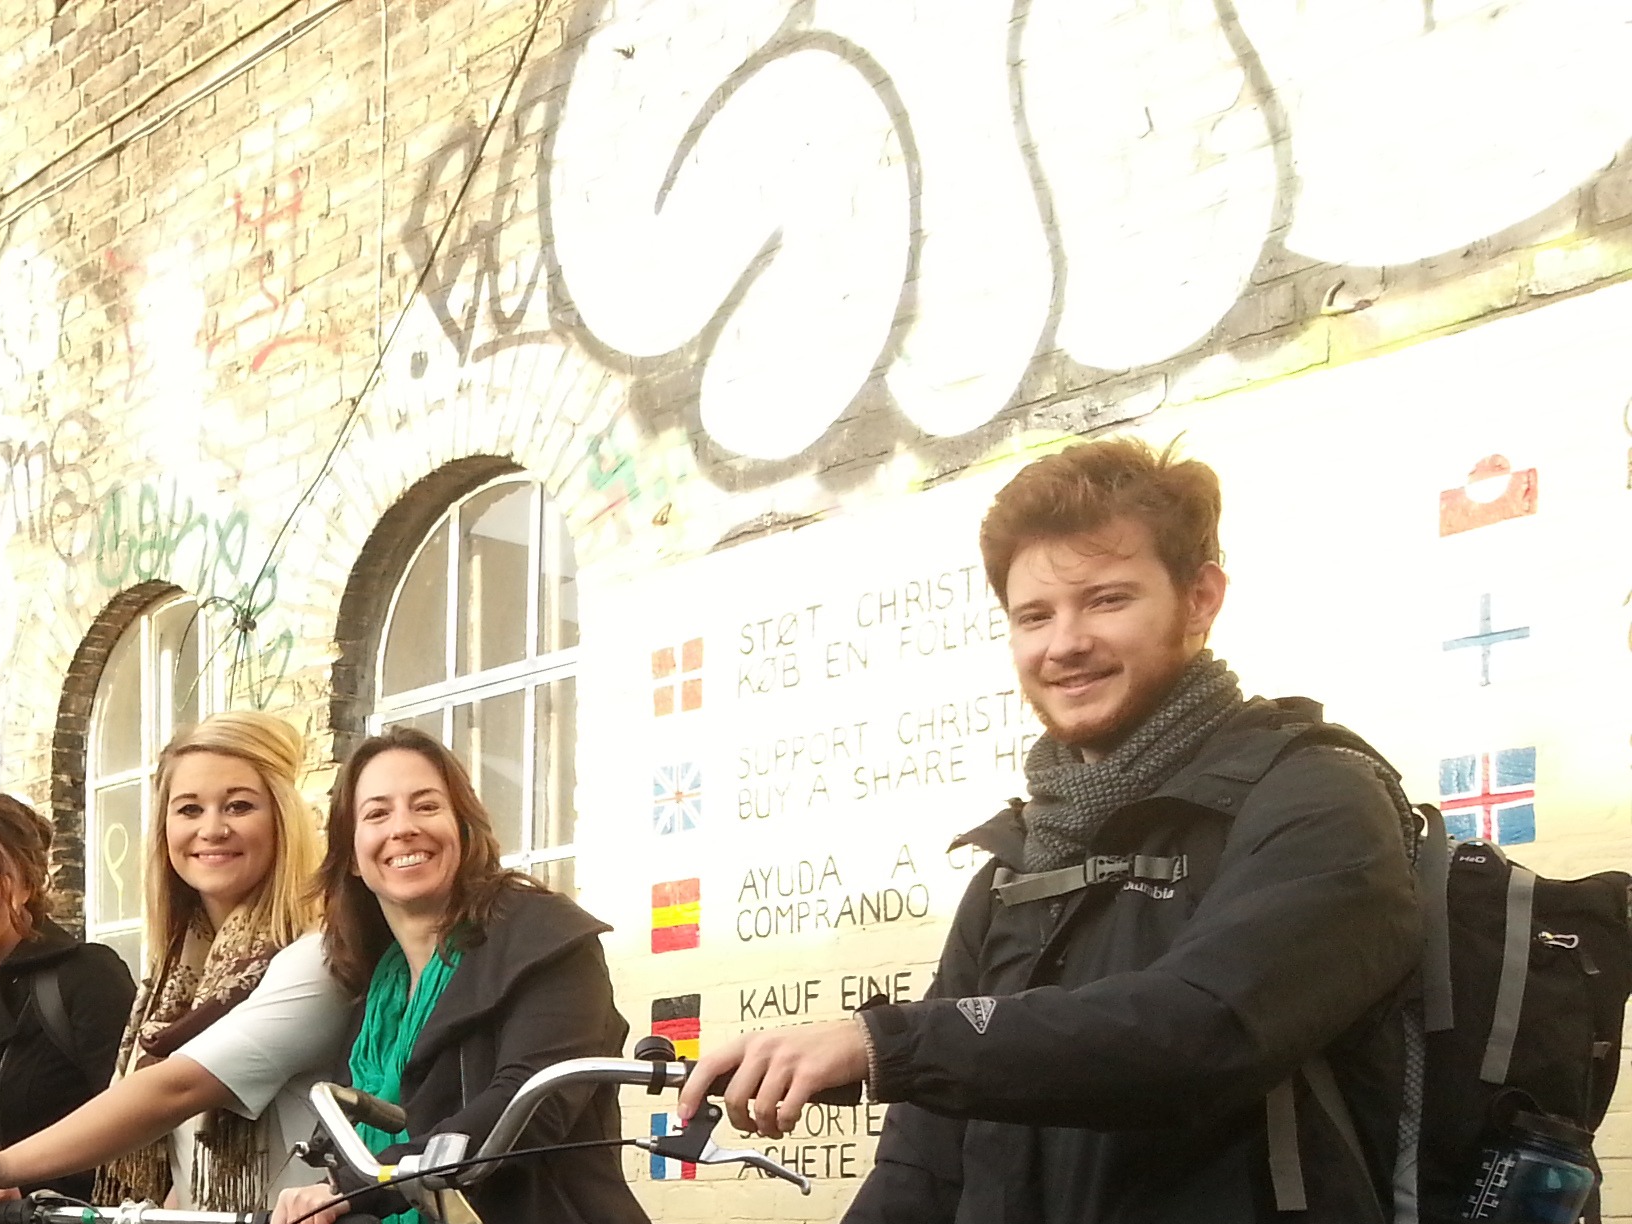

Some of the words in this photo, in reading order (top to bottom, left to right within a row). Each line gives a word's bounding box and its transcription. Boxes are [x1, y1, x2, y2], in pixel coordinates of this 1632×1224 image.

[737, 653, 800, 699] KØB
[826, 642, 868, 679] EN
[737, 722, 868, 781] SUPPORT
[738, 782, 791, 820] BUY
[807, 775, 830, 807] A
[853, 745, 967, 801] SHARE
[738, 855, 842, 902] AYUDA
[891, 844, 916, 879] A
[737, 884, 930, 942] COMPRANDO
[740, 980, 822, 1022] KAUF
[841, 972, 912, 1011] EINE
